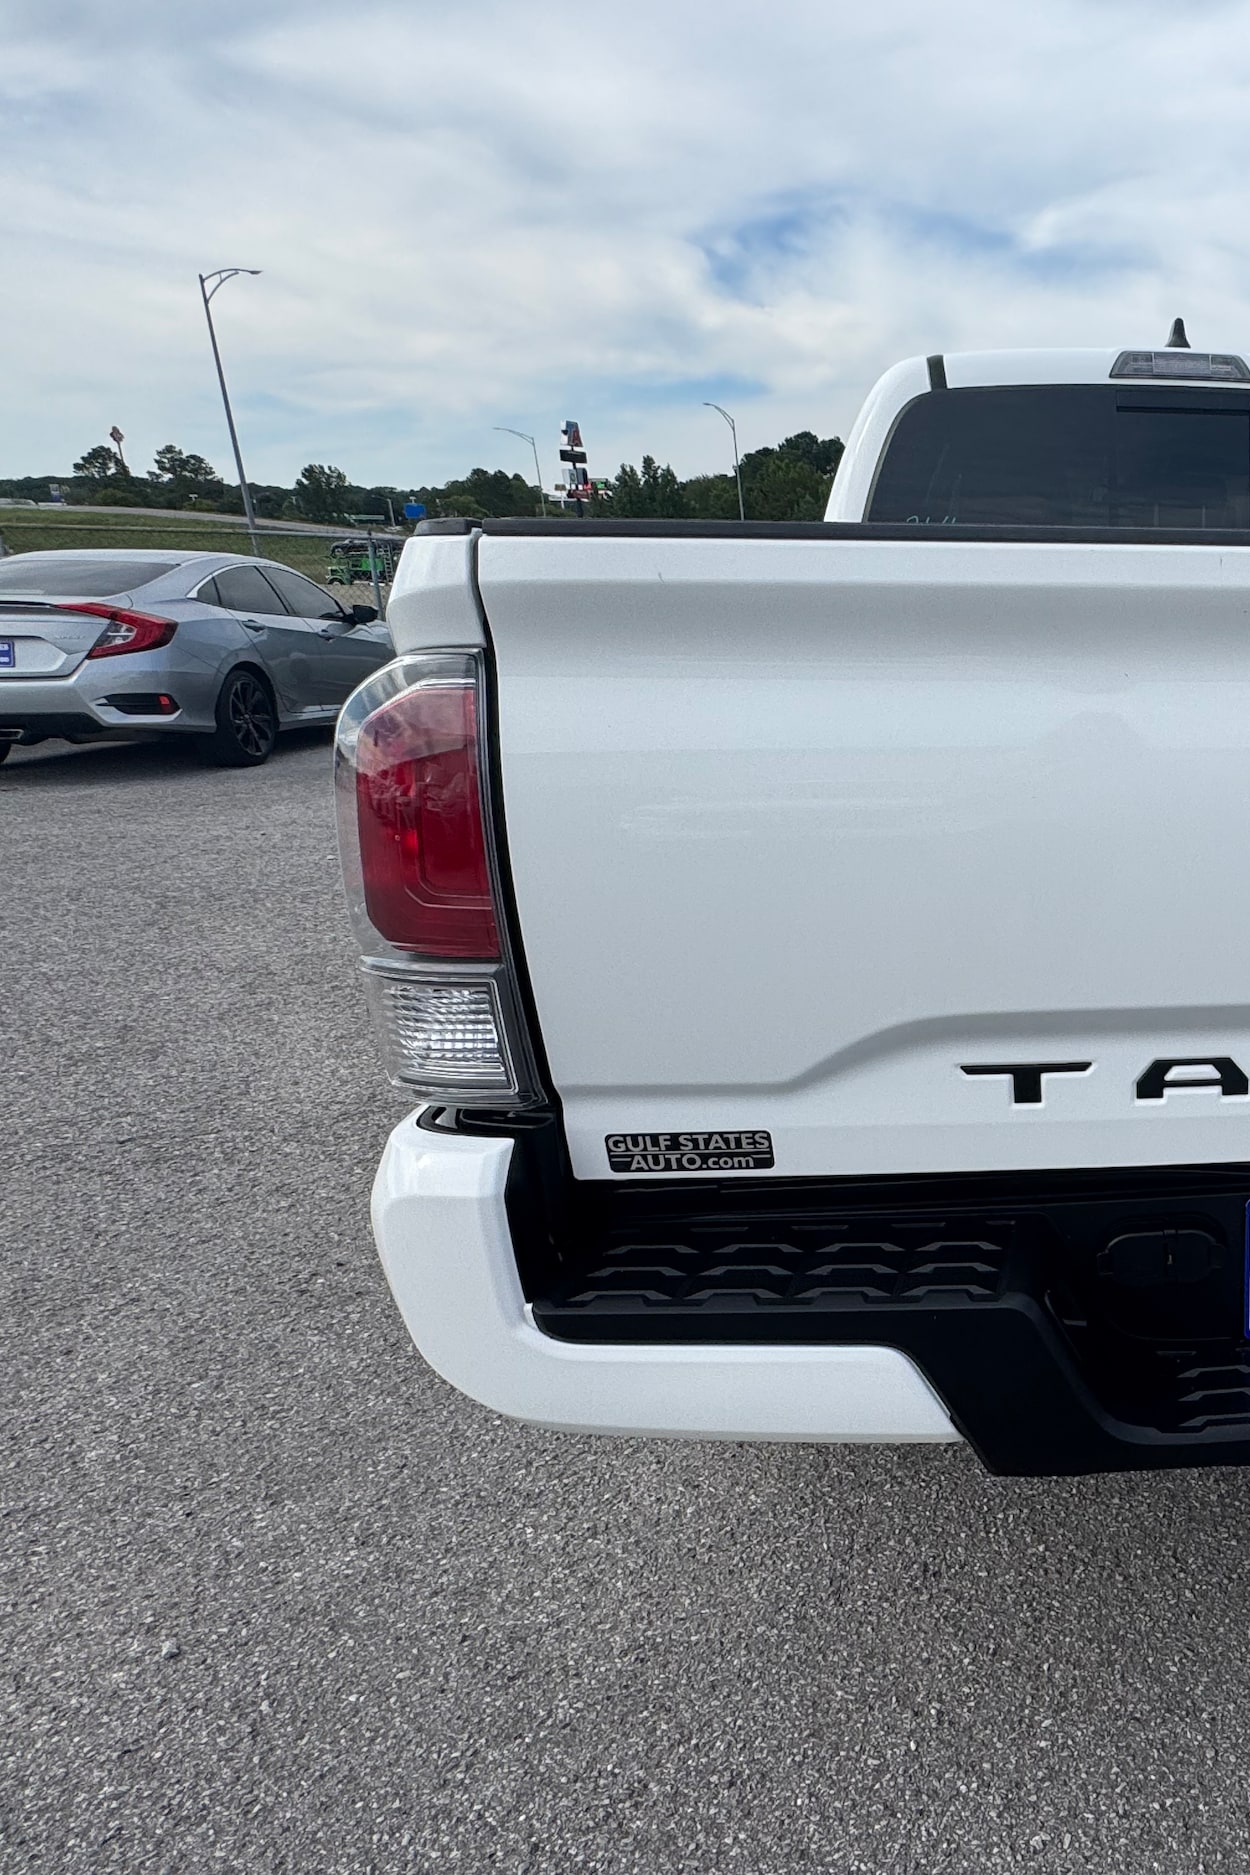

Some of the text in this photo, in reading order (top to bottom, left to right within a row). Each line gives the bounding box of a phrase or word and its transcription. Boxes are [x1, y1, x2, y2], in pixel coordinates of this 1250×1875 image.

[607, 1132, 770, 1152] GULF STATES
[630, 1153, 755, 1171] AUTO.com
